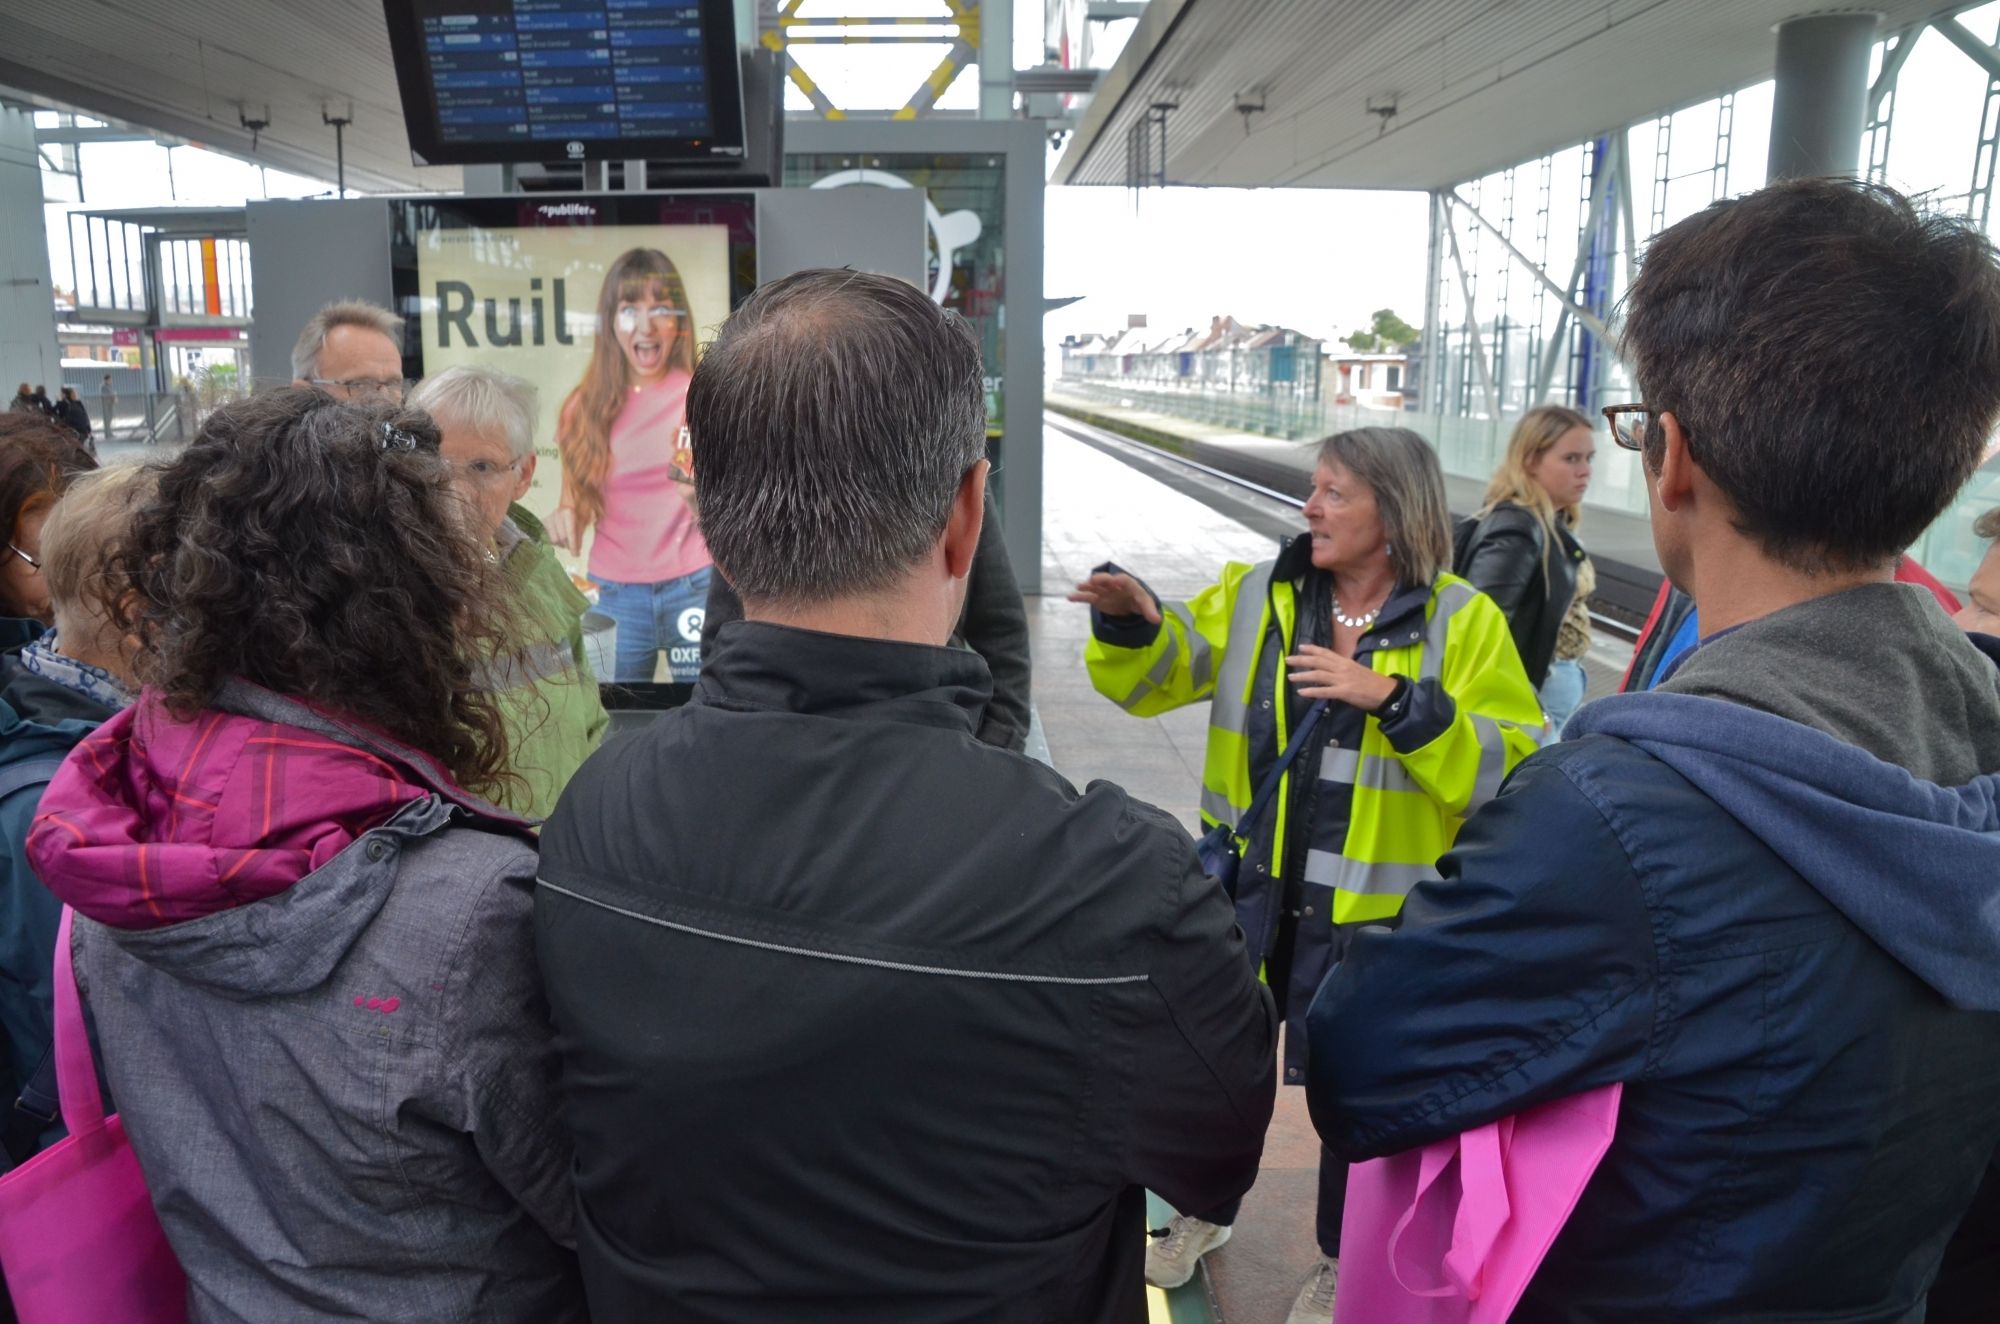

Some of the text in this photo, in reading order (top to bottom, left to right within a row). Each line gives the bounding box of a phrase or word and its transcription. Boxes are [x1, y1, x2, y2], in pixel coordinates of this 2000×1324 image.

[547, 203, 590, 218] publifer
[436, 278, 574, 348] Ruil
[983, 375, 1003, 392] er
[535, 446, 559, 460] king
[670, 647, 702, 663] OXF
